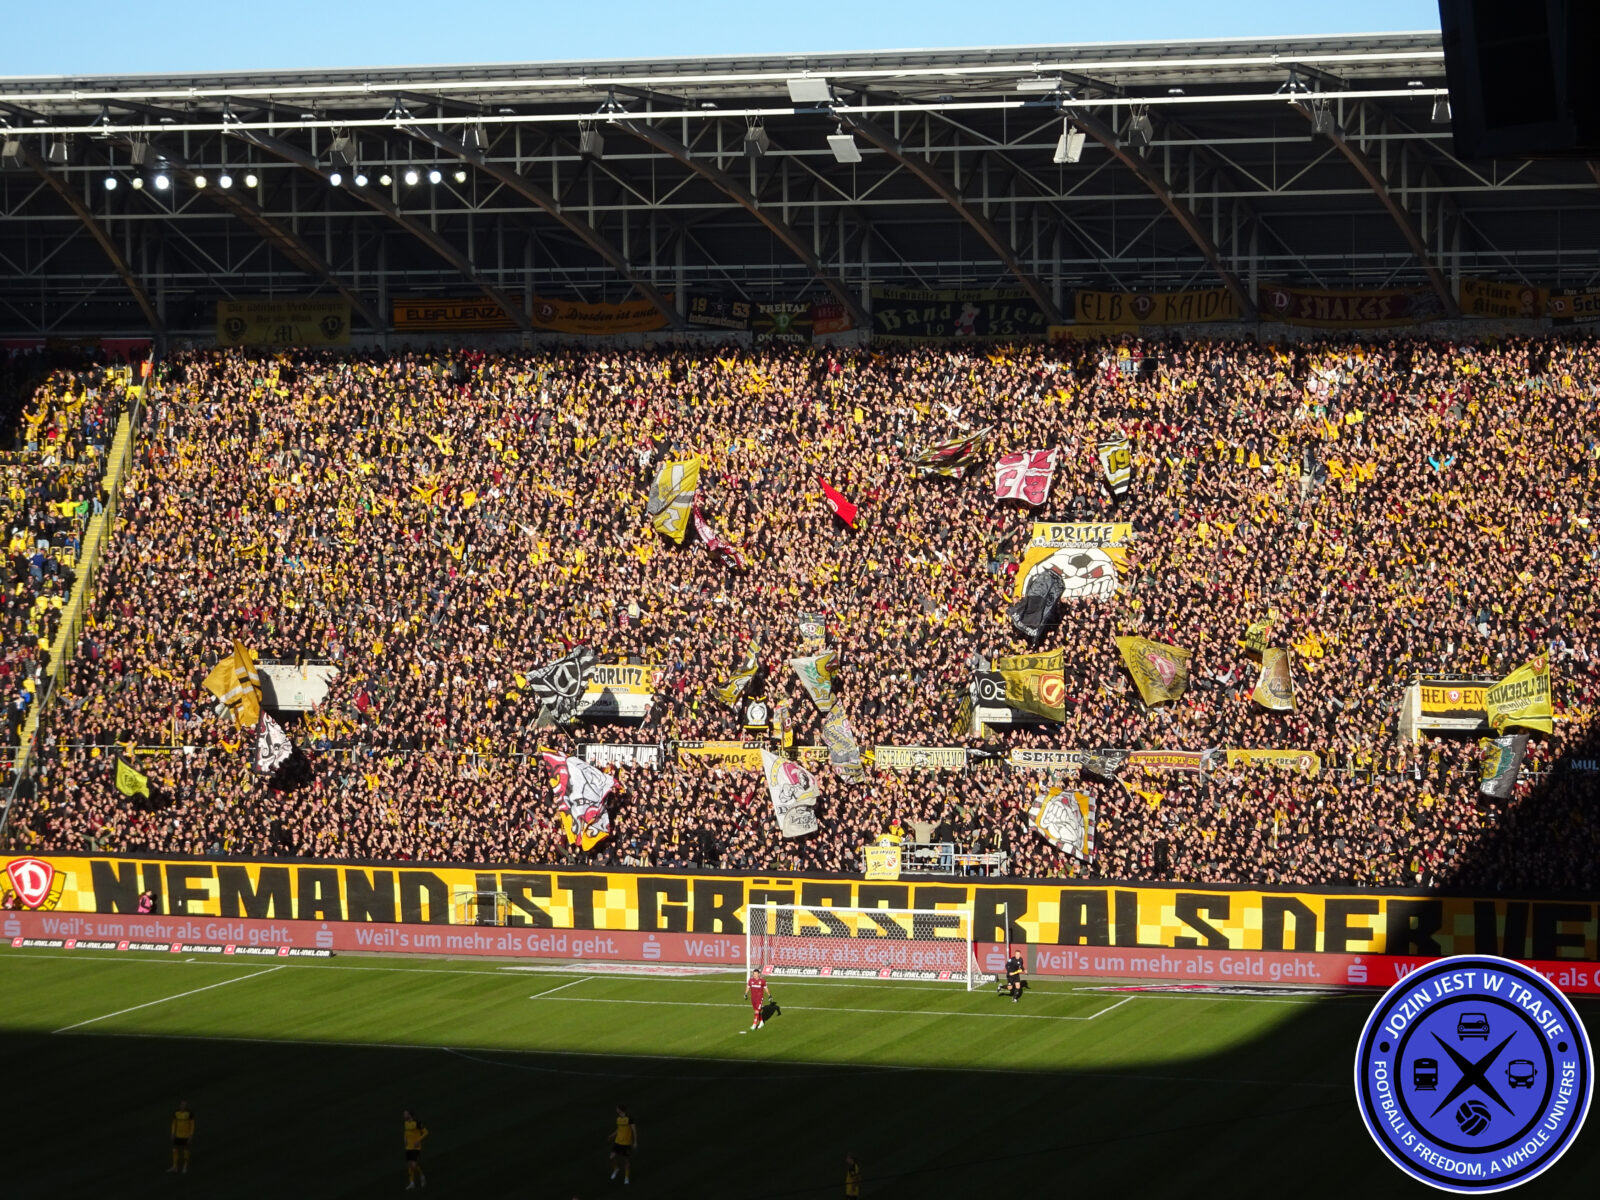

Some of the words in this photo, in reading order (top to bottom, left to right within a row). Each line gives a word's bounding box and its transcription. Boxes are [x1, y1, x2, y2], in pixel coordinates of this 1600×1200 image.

[692, 297, 708, 312] 19
[731, 302, 751, 318] 53
[760, 303, 807, 313] FREITAL
[1081, 294, 1123, 321] ELB
[1165, 289, 1234, 321] KAIDA
[757, 334, 773, 342] ON
[775, 334, 805, 342] TOUR
[1051, 526, 1113, 541] DRITTE
[1128, 755, 1186, 765] AKTIVIST
[90, 861, 449, 926] NIEMAND
[475, 873, 608, 929] IST
[637, 877, 1028, 943] GRÖSSER
[1058, 890, 1230, 949] ALS
[1262, 896, 1442, 955] DER
[42, 918, 93, 935] Weil's
[99, 923, 127, 937] um
[129, 920, 177, 939] mehr
[179, 921, 200, 940] als
[205, 923, 244, 941] Geld
[249, 924, 293, 945] geht.
[355, 927, 409, 947] Weil's
[414, 933, 440, 948] um
[446, 930, 494, 950] mehr
[497, 932, 522, 951] als
[527, 934, 567, 952] Geld
[572, 936, 619, 956] geht.
[684, 939, 741, 957] Weil's
[780, 944, 830, 961] mehr
[833, 945, 857, 962] als
[865, 945, 907, 964] Geld
[1036, 952, 1088, 969] Weil's
[1094, 957, 1123, 971] um
[1130, 954, 1179, 972] mehr
[1186, 955, 1213, 974] als
[1215, 957, 1264, 976] Geld
[1269, 959, 1320, 981] geht.
[1559, 968, 1588, 987] als
